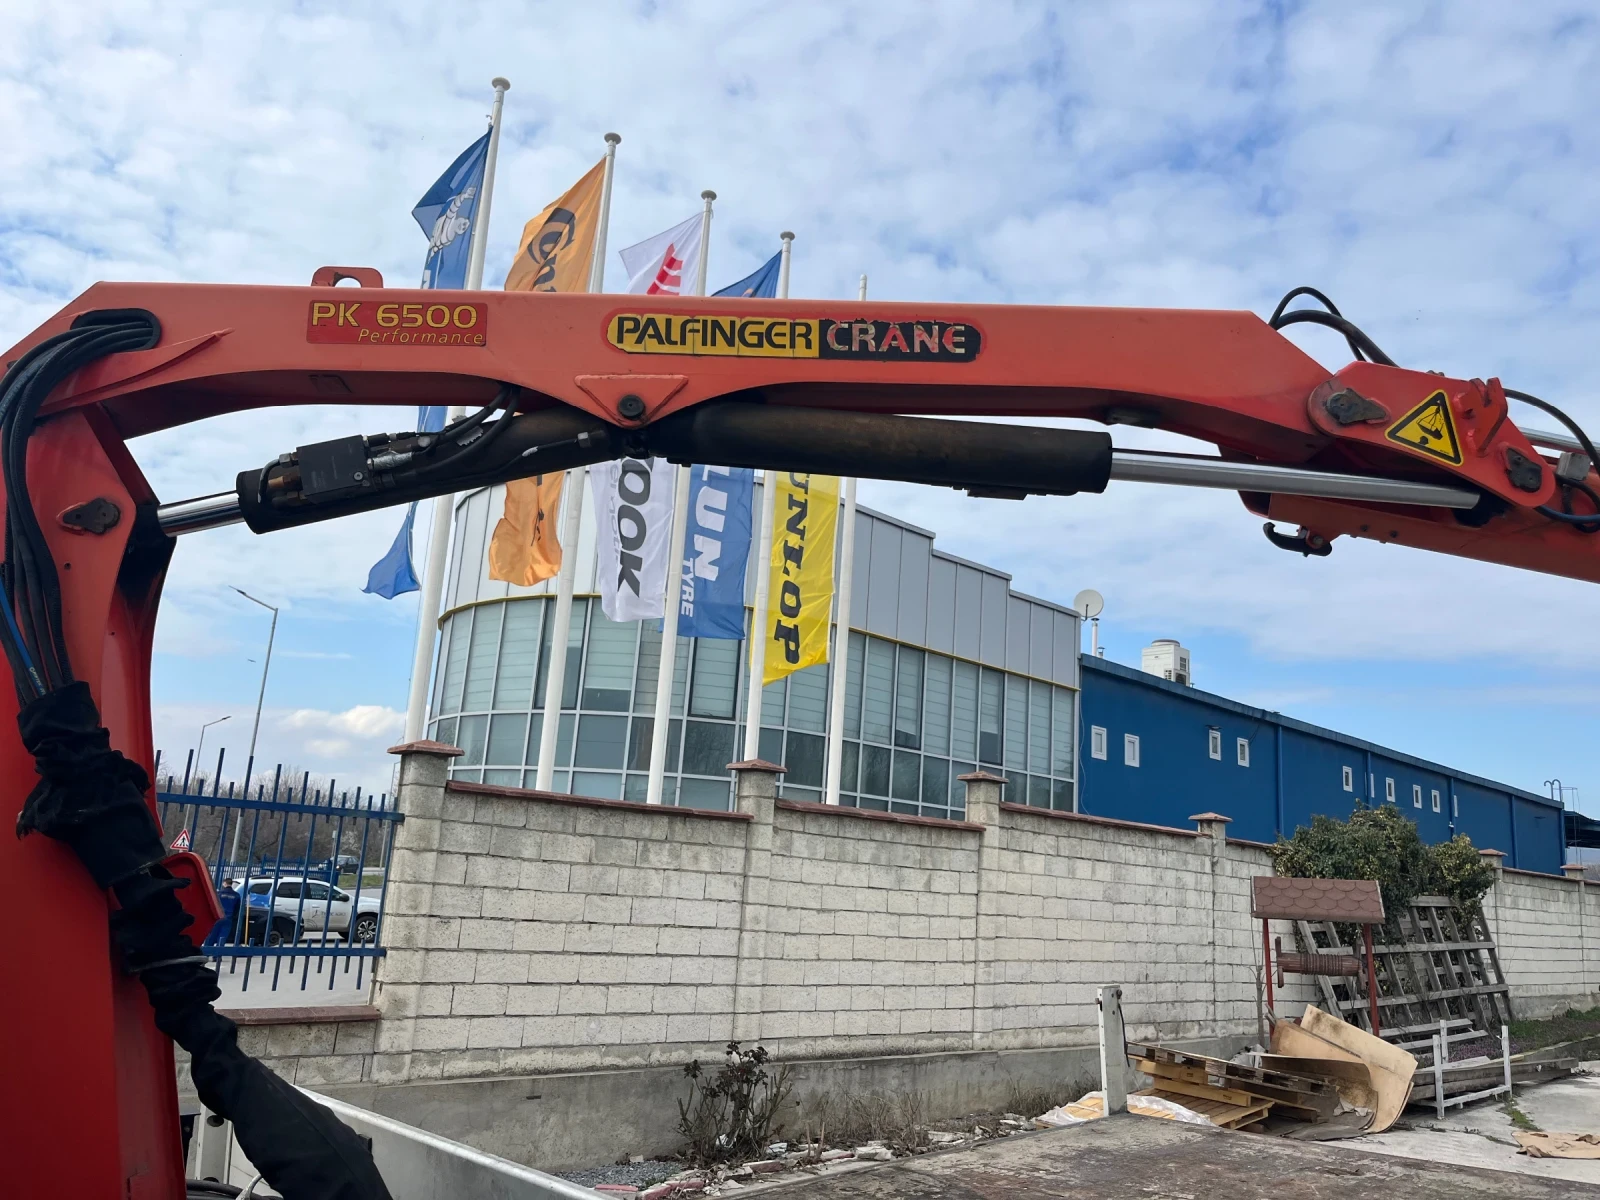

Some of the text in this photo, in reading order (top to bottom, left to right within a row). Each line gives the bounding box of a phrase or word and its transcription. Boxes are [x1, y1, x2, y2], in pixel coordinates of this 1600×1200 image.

[311, 302, 478, 329] PK 6500
[357, 328, 484, 345] Performance
[616, 316, 813, 350] PALFINGER
[826, 322, 966, 355] CRANE
[617, 457, 654, 598] OOK
[681, 558, 695, 618] TYRE
